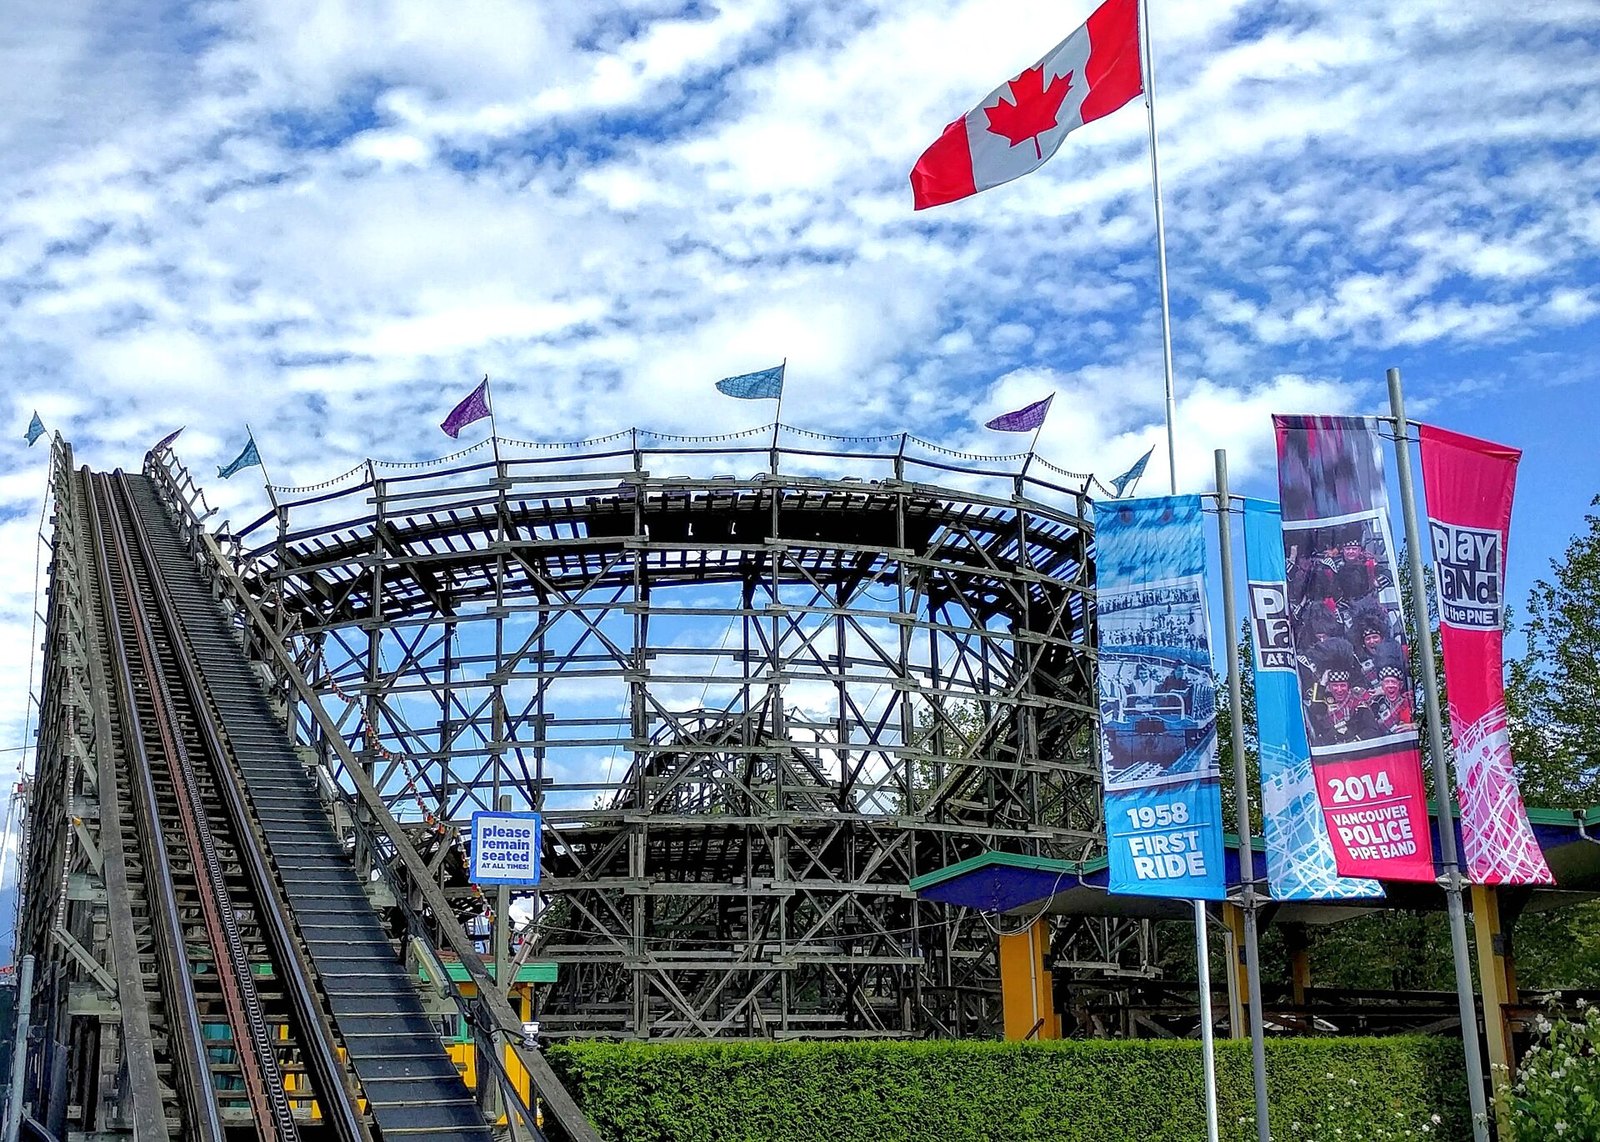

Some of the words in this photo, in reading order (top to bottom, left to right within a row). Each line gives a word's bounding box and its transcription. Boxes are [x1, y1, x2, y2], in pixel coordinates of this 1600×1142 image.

[1450, 607, 1465, 622] the
[1467, 610, 1494, 624] PNE
[1265, 652, 1285, 666] At
[1328, 771, 1394, 803] 2014
[1126, 802, 1189, 829] 1958
[1332, 805, 1408, 826] VANCOUVER
[482, 825, 531, 839] please
[1337, 818, 1414, 846] POLICE
[482, 839, 530, 850] remain
[1128, 830, 1199, 857] FIRST
[1347, 845, 1381, 860] PIPE
[1380, 840, 1417, 859] BAND
[481, 851, 530, 862] seated
[1132, 851, 1207, 880] RIDE
